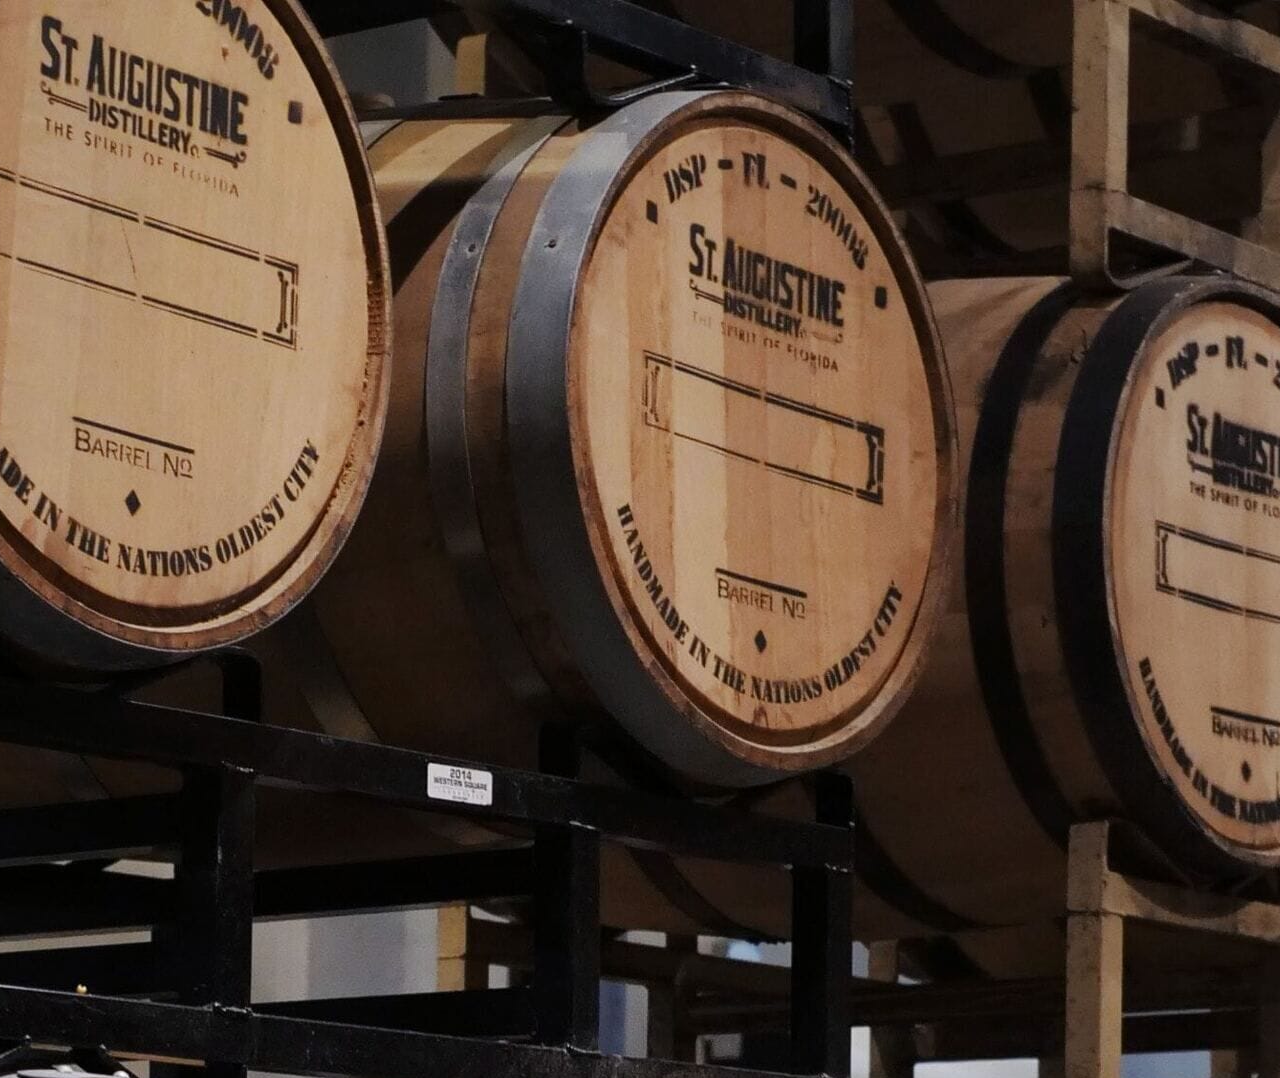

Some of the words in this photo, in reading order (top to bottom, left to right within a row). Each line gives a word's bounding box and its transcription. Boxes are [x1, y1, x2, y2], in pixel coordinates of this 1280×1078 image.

[86, 35, 248, 145] AUGUSTINE
[45, 117, 74, 142] THE
[86, 99, 191, 153] DISTILLERY
[661, 153, 706, 203] DSP
[742, 151, 770, 189] FL
[722, 237, 844, 328] AUGUSTINE
[722, 293, 801, 337] DISTILLERY
[765, 336, 781, 353] OF
[72, 427, 155, 472] BARREL
[33, 493, 63, 533] IN
[64, 516, 111, 566] THE
[115, 542, 214, 578] NATIONS
[215, 493, 286, 565] OLDEST
[283, 438, 320, 502] CITY
[616, 504, 689, 644] HANDMADE
[688, 634, 710, 669] IN
[711, 653, 746, 696] THE
[749, 675, 823, 705] NATIONS
[823, 630, 876, 693] OLDEST
[874, 581, 902, 637] CITY
[716, 577, 778, 614] BARREL
[434, 777, 463, 788] WESTERN
[450, 769, 472, 780] 2014
